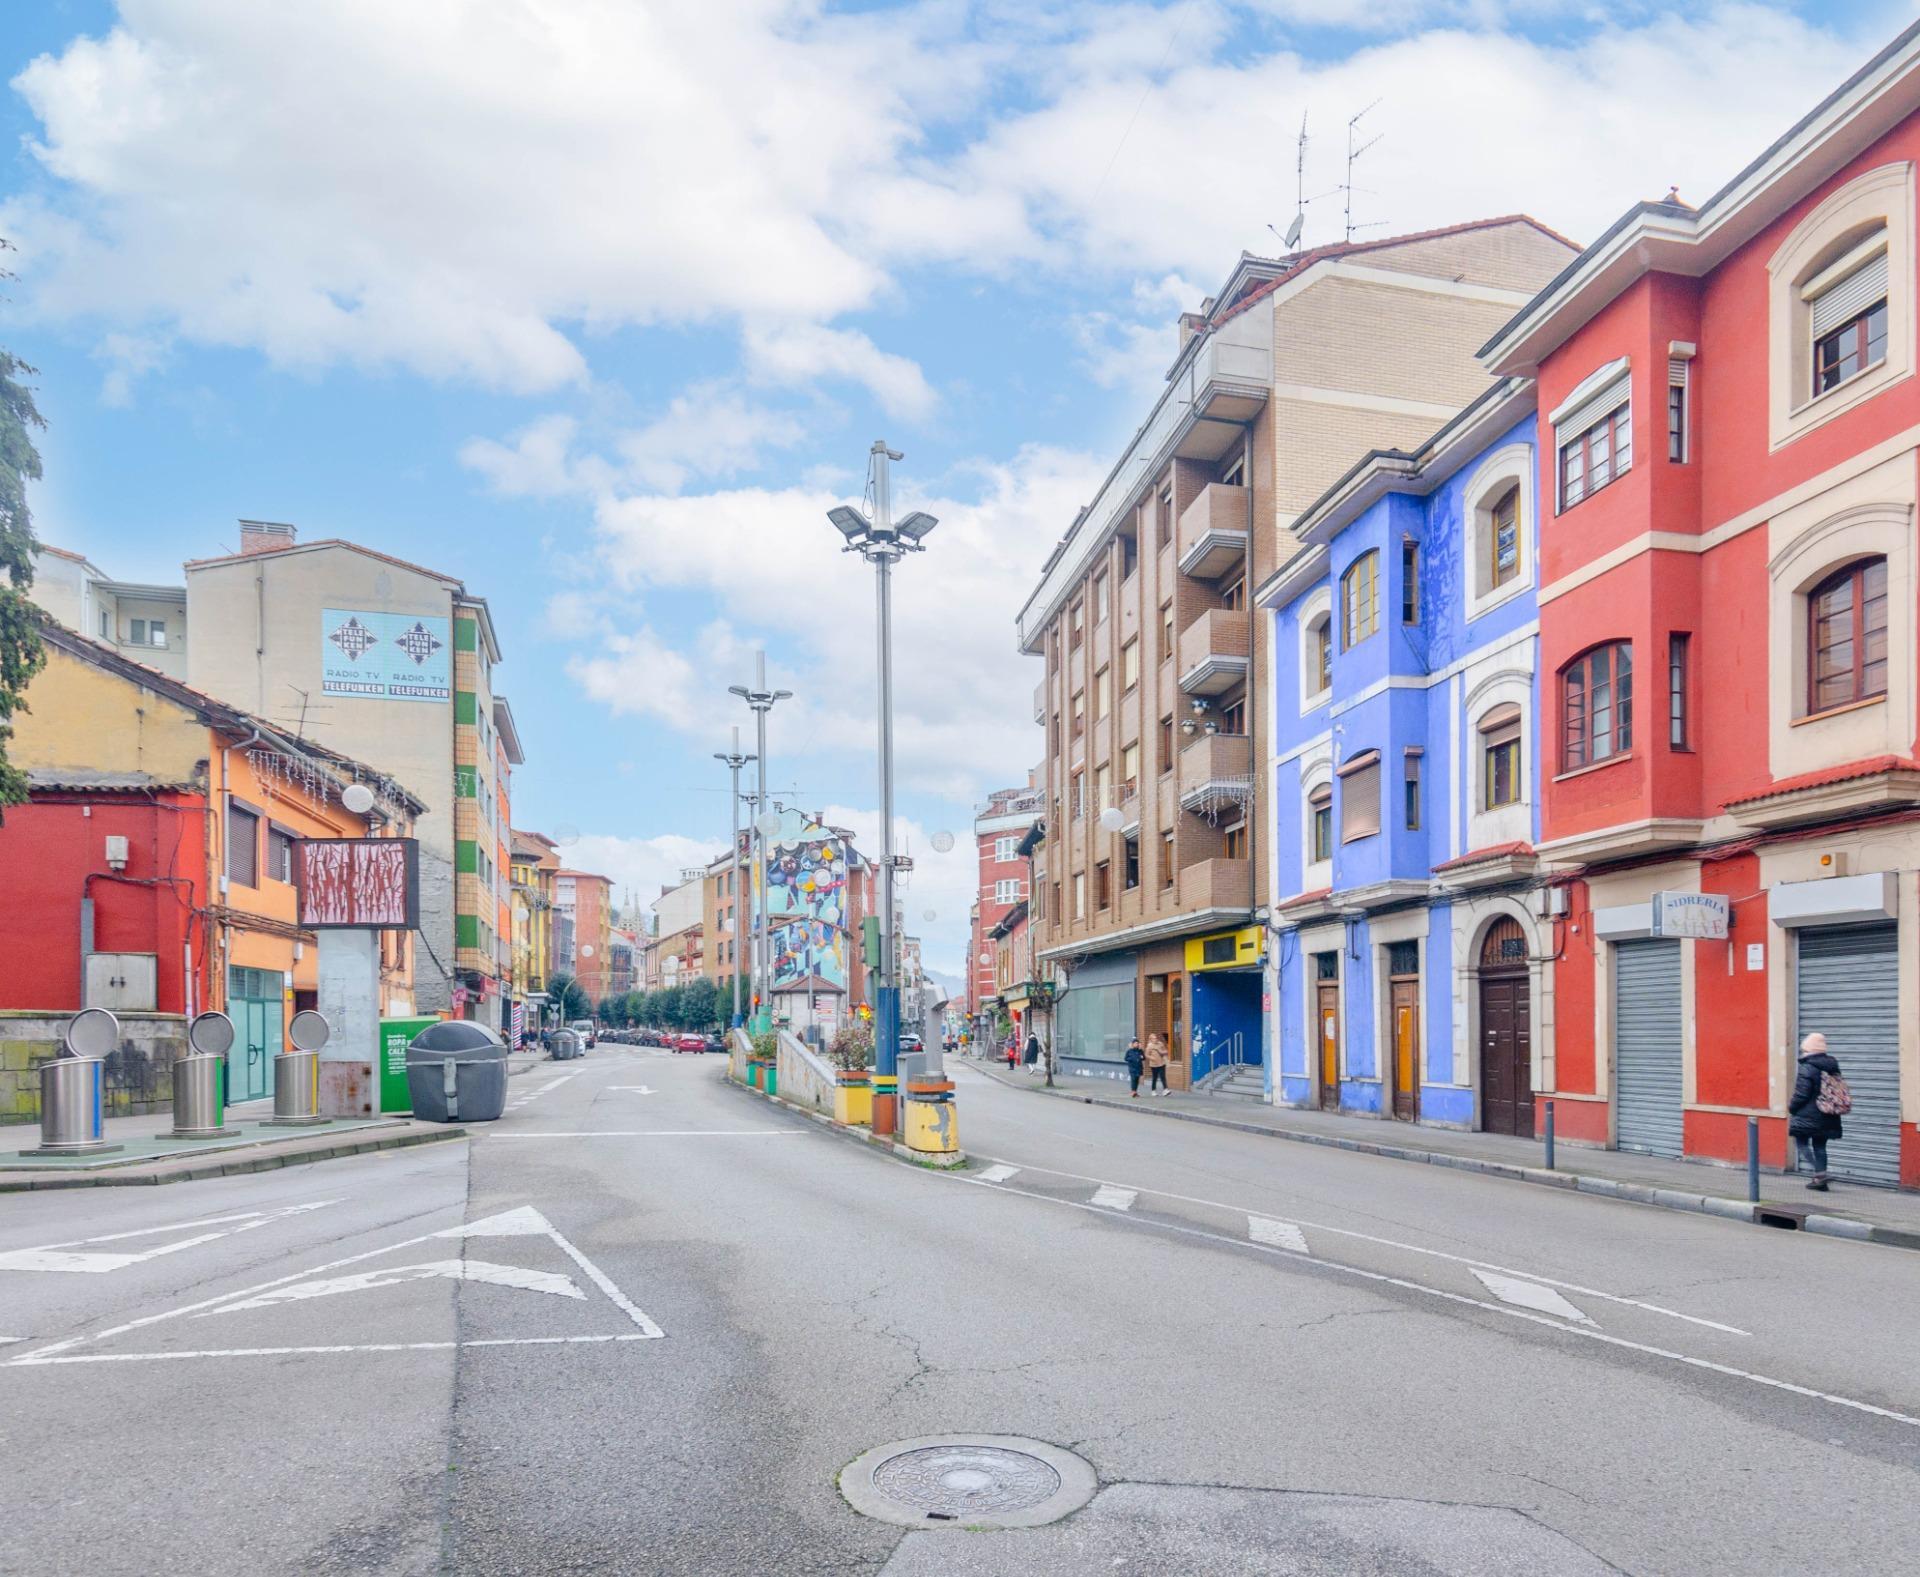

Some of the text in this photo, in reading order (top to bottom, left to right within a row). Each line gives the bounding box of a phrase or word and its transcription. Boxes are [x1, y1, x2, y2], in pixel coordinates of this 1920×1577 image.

[343, 635, 364, 643] FUN
[409, 640, 430, 648] FUN
[327, 670, 359, 678] RADIO
[393, 674, 424, 682] RADIO
[325, 682, 384, 693] TELEFUNKEN
[391, 686, 448, 698] TELEFUNKEN
